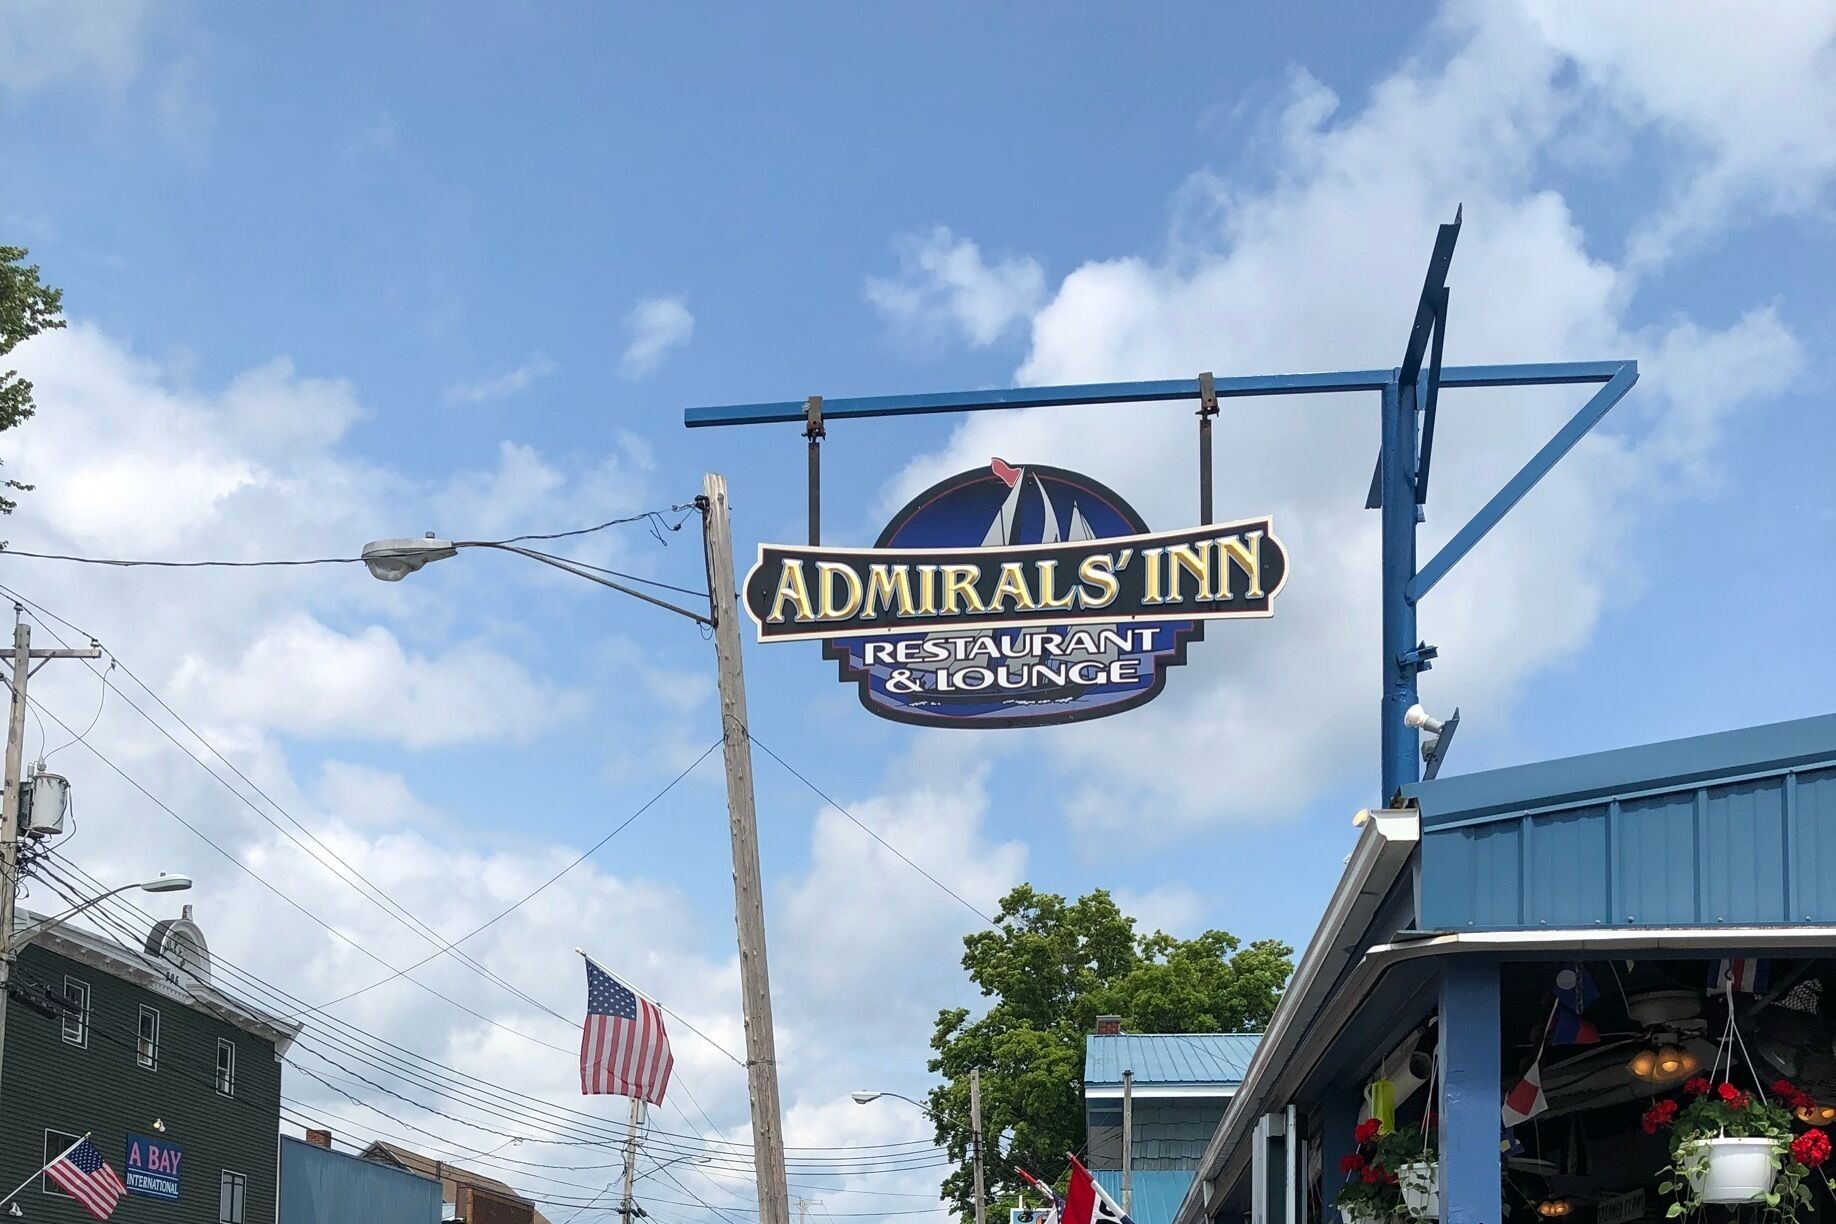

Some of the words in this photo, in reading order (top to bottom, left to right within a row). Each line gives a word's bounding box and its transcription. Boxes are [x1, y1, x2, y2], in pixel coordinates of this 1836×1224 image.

[766, 548, 1132, 624] ADMIRALS'
[1142, 531, 1266, 605] INN
[864, 628, 1160, 665] RESTAURANT
[885, 669, 923, 694] &
[936, 659, 1140, 691] LOUNGE
[129, 1141, 141, 1167] A
[148, 1145, 181, 1175] BAY
[126, 1172, 179, 1195] INTERNATIONAL
